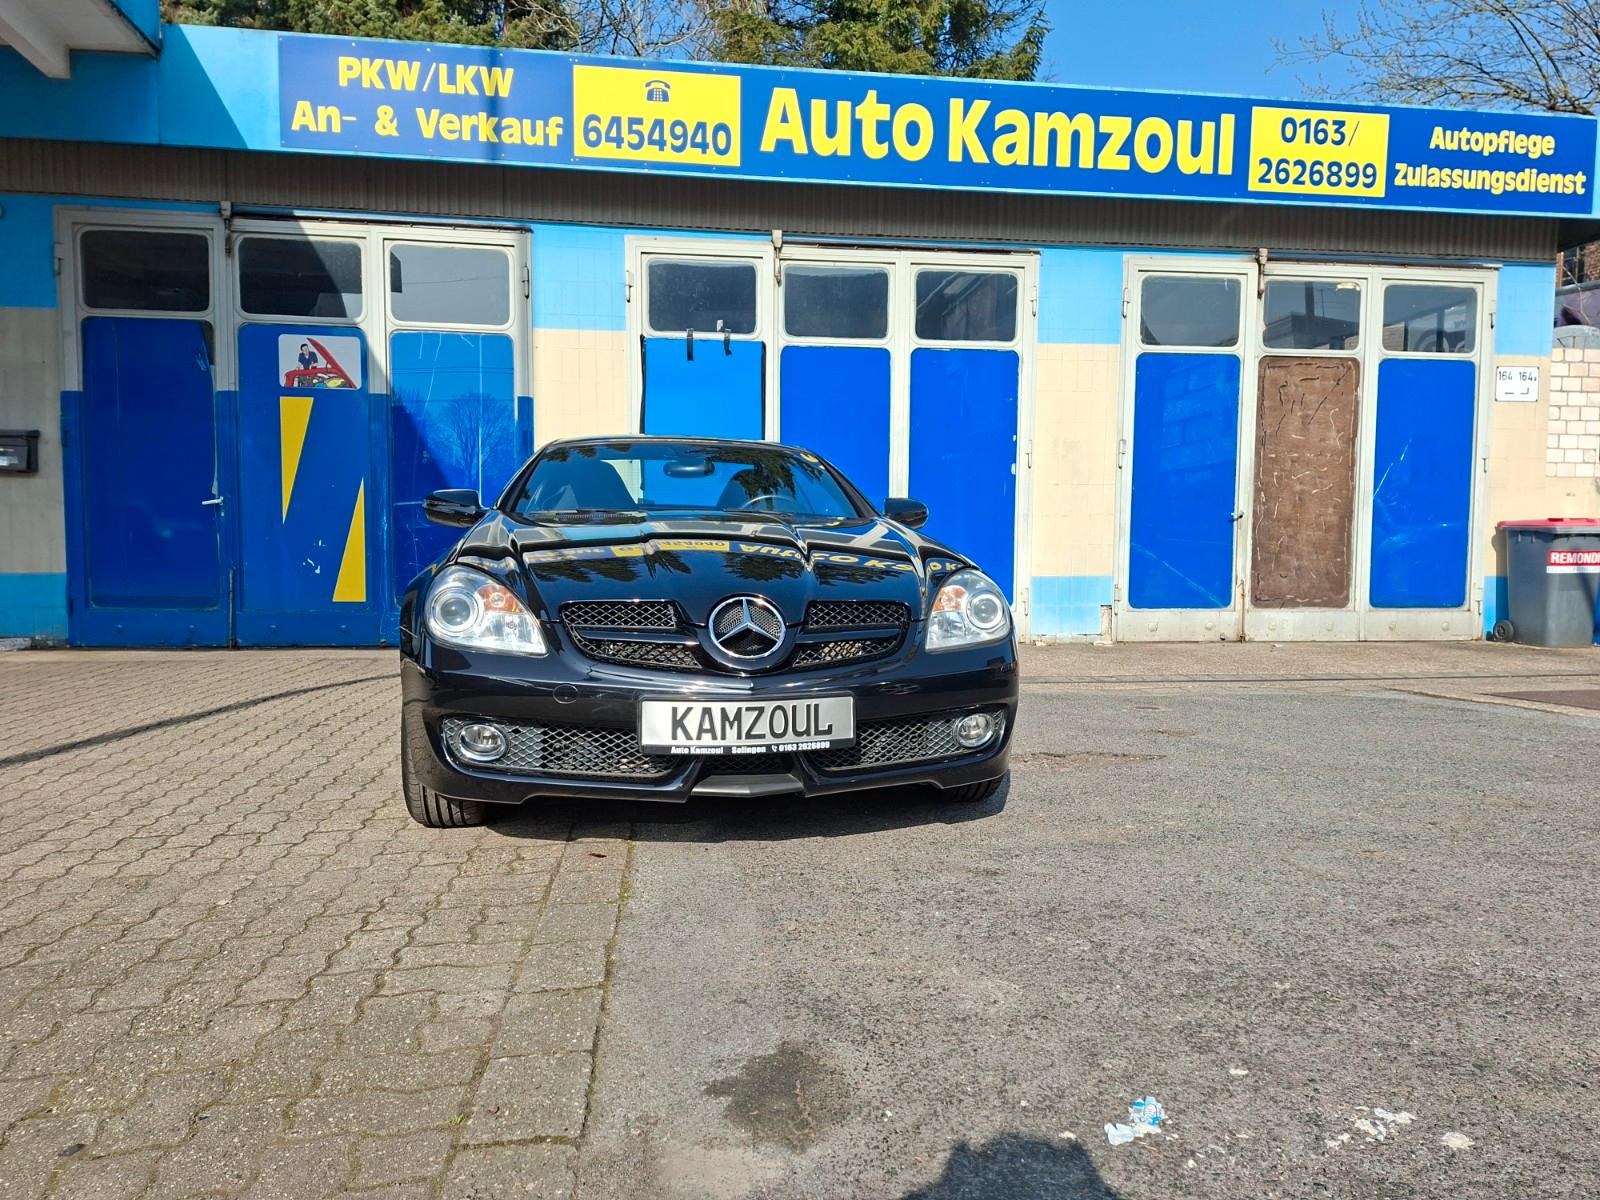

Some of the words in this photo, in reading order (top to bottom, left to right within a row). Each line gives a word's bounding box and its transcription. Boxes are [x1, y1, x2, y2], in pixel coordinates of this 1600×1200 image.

[338, 56, 515, 98] PKW/LKW
[291, 100, 357, 133] An-
[374, 105, 399, 137] &
[415, 107, 564, 147] Verkauf
[583, 114, 733, 155] 6454940
[760, 87, 934, 161] Auto
[948, 98, 1236, 175] Kamzoul
[1280, 117, 1360, 147] 0163/
[1429, 126, 1556, 157] Autopflege
[1258, 157, 1378, 189] 2626899
[1394, 162, 1587, 195] Zulassungsdienst
[1498, 371, 1513, 381] 164
[671, 703, 833, 741] KAMZOUL
[670, 746, 689, 755] Auto
[690, 746, 724, 755] Kamzoul
[731, 745, 767, 755] Solingen
[778, 744, 797, 752] 0163
